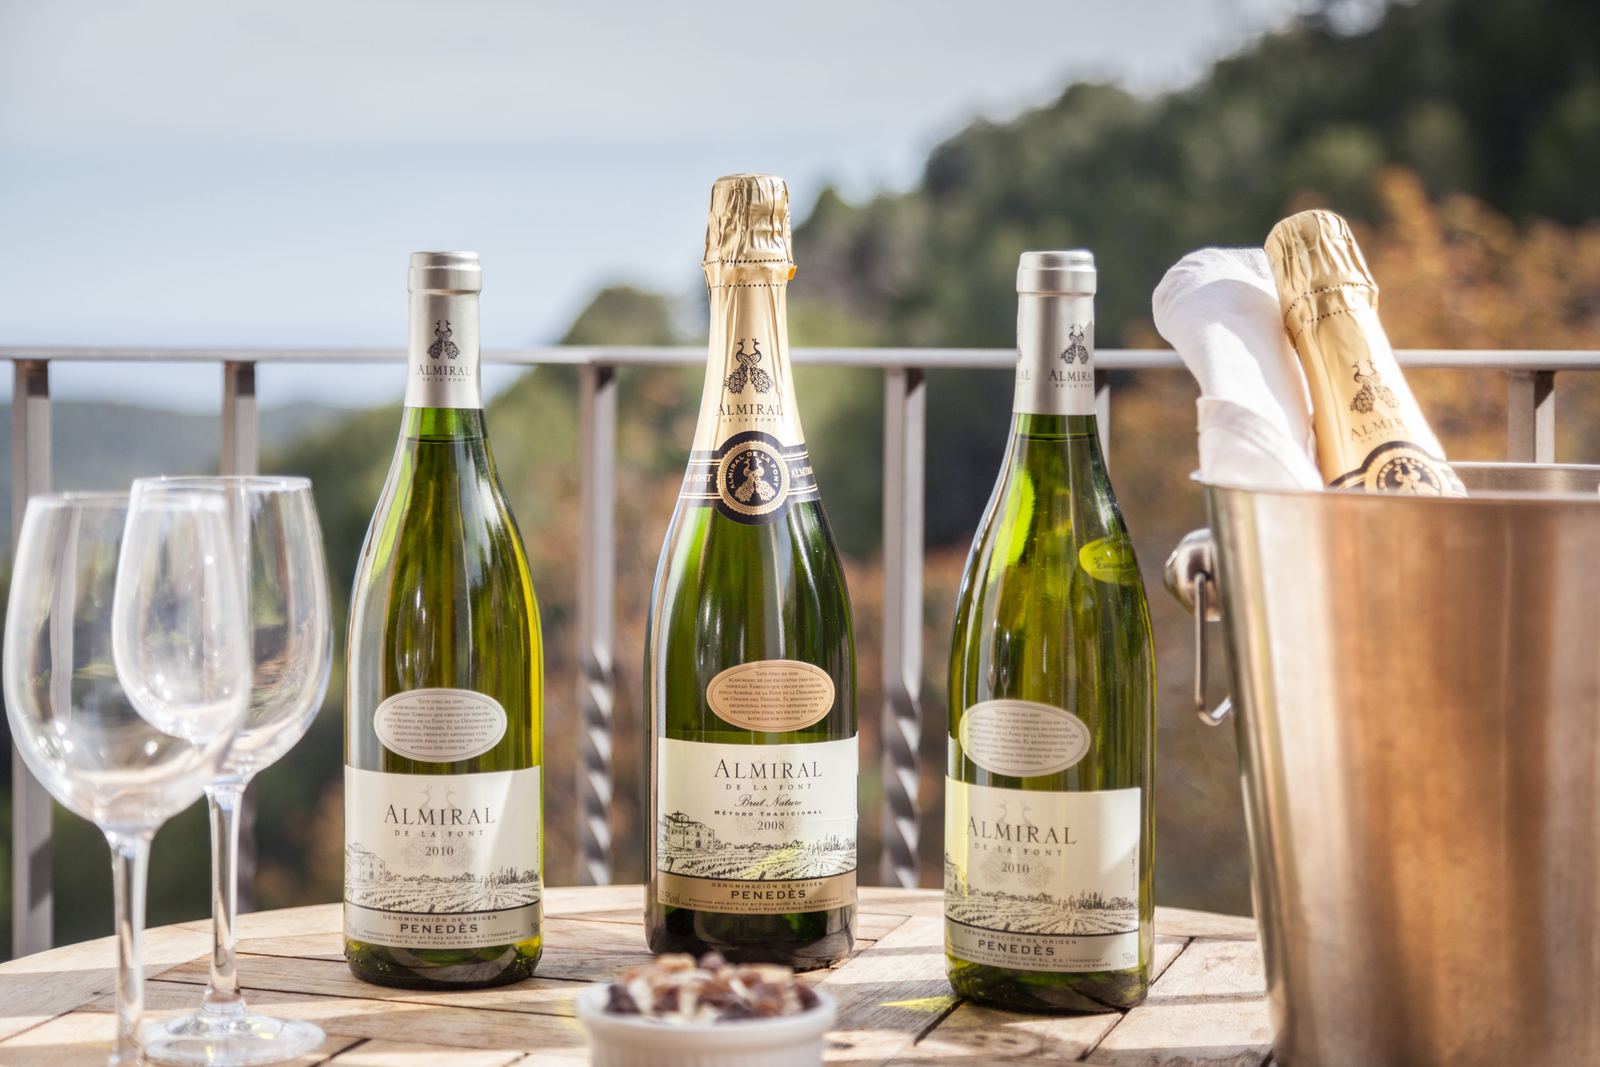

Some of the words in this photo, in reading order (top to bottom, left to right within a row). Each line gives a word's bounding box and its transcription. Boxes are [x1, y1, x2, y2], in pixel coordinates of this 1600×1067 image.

[417, 364, 471, 376] ALMIRAL
[1049, 369, 1094, 382] ALMIRA
[716, 402, 783, 417] ALMIRAL
[1350, 418, 1407, 441] ALMIR
[713, 758, 823, 780] ALMIRAL
[725, 783, 741, 791] DE
[779, 782, 812, 791] FONT
[733, 793, 765, 808] Brut
[765, 793, 804, 808] Nature
[384, 803, 497, 826] ALMIRAL
[713, 808, 755, 817] MÉTODO
[759, 809, 823, 818] TRADICIONAL
[756, 820, 786, 832] 2008
[967, 815, 1078, 846] ALMIRAL
[421, 830, 437, 838] LA
[448, 829, 485, 838] FONT
[425, 846, 455, 857] 2010
[974, 842, 987, 851] DE
[997, 846, 1013, 854] LA
[1023, 847, 1063, 857] FONT
[1001, 861, 1031, 875] 2010
[731, 887, 807, 900] PENEDÈS
[399, 922, 479, 934] PENEDÈS
[978, 938, 1056, 957] PENEDÈS
